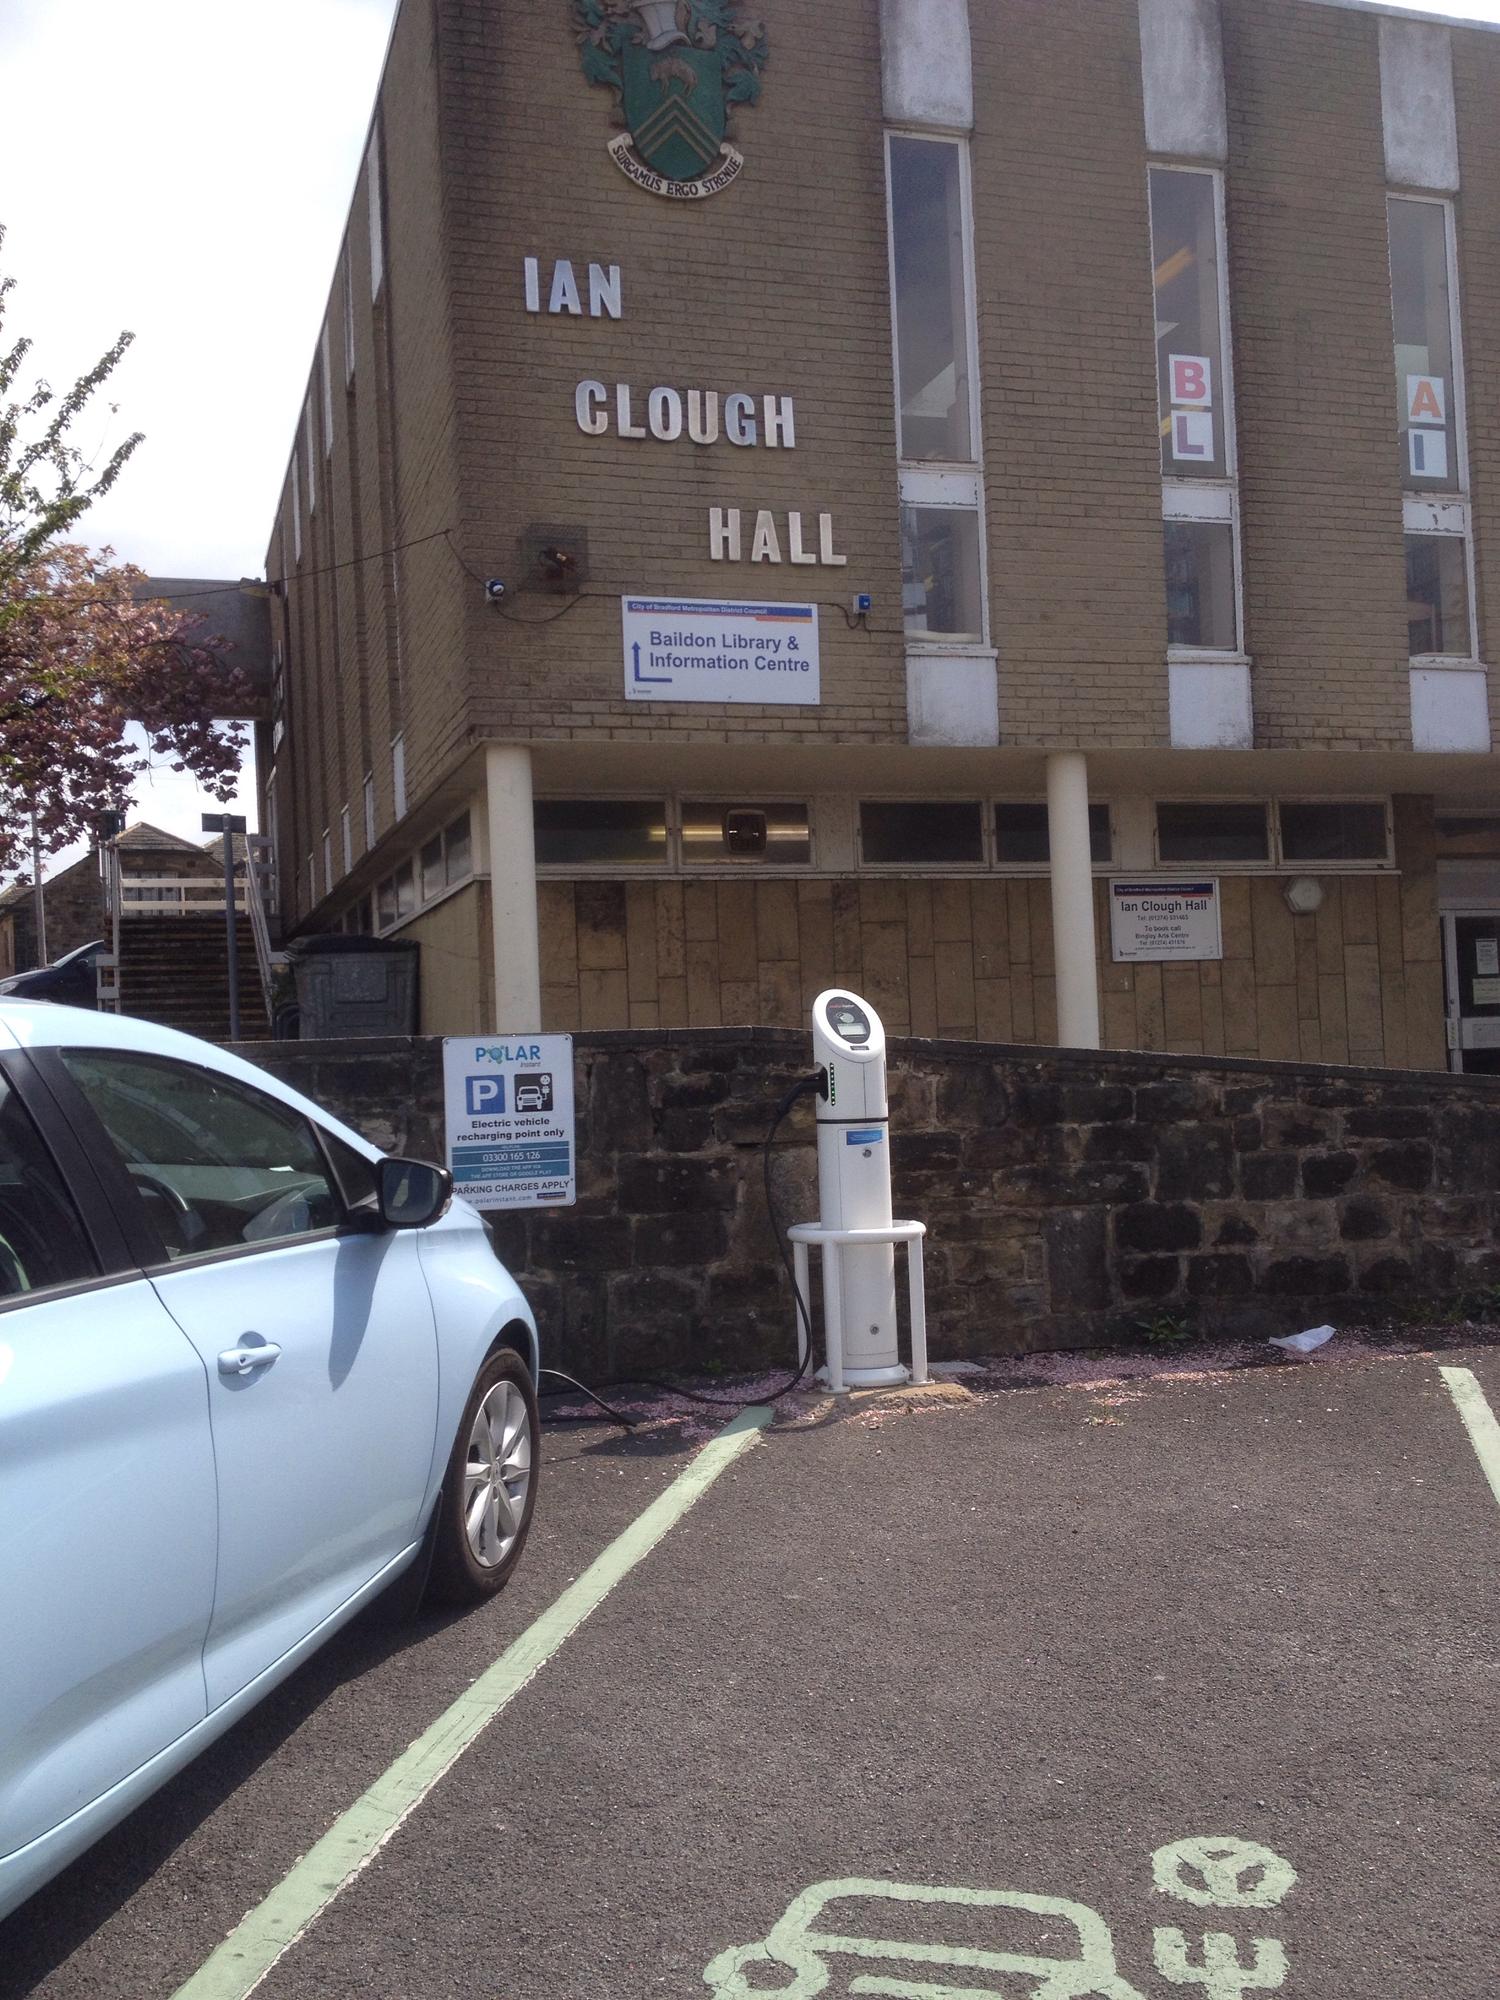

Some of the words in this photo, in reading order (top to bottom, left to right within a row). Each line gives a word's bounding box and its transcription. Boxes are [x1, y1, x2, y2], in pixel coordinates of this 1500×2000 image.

[612, 144, 662, 191] SURGAMUS
[667, 183, 698, 197] ERGO
[702, 156, 741, 193] STRENUE
[523, 256, 623, 319] IAN
[575, 380, 796, 449] CLOUGH
[708, 506, 848, 567] HALL
[632, 603, 644, 611] City
[682, 605, 720, 613] Metropolitan
[650, 631, 716, 647] Baildon
[722, 633, 781, 653] Library
[787, 636, 799, 650] &
[650, 652, 749, 670] Information
[755, 655, 810, 672] Centre
[1121, 901, 1138, 911] Ian
[1141, 900, 1182, 913] Clough
[1185, 900, 1207, 911] Hall
[475, 1045, 541, 1063] POLAR
[472, 1080, 498, 1111] P
[471, 1119, 511, 1129] Electric
[514, 1117, 550, 1127] vehicle
[457, 1132, 512, 1142] recharging
[515, 1129, 541, 1140] point
[543, 1128, 565, 1138] only
[482, 1153, 508, 1162] 03300
[510, 1152, 524, 1160] 165
[526, 1151, 541, 1160] 126
[451, 1186, 492, 1195] PARKING
[495, 1182, 539, 1192] CHARGES
